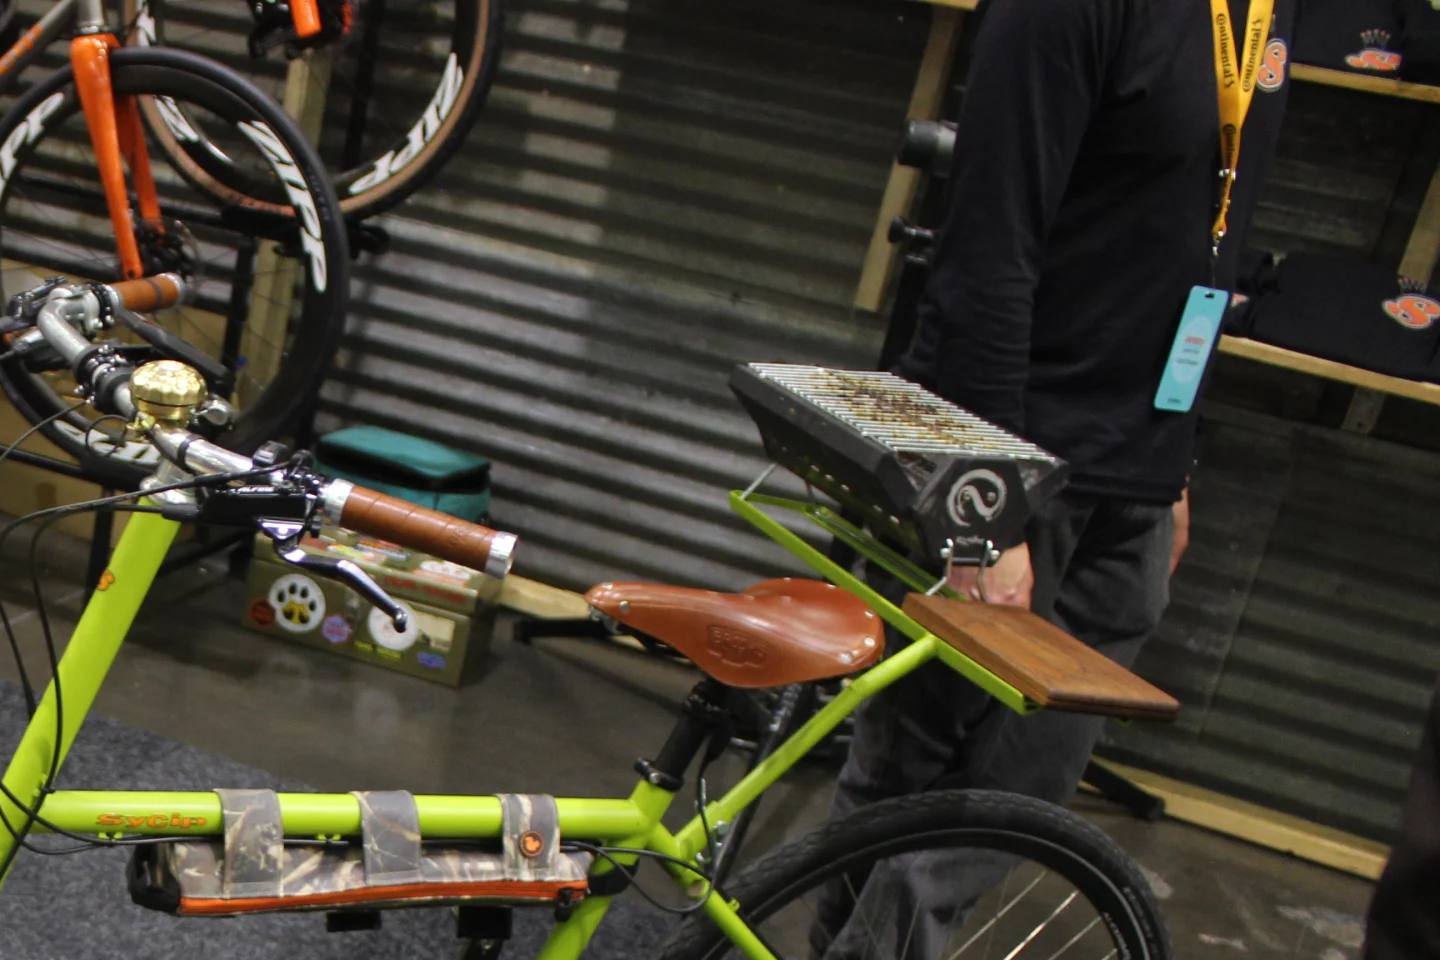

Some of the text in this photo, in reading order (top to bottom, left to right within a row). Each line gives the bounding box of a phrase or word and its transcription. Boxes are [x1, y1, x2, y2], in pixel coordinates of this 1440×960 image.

[348, 52, 464, 195] ZIPP
[237, 120, 327, 293] ZIPP
[54, 420, 161, 464] IPP
[96, 812, 207, 829] SyCip
